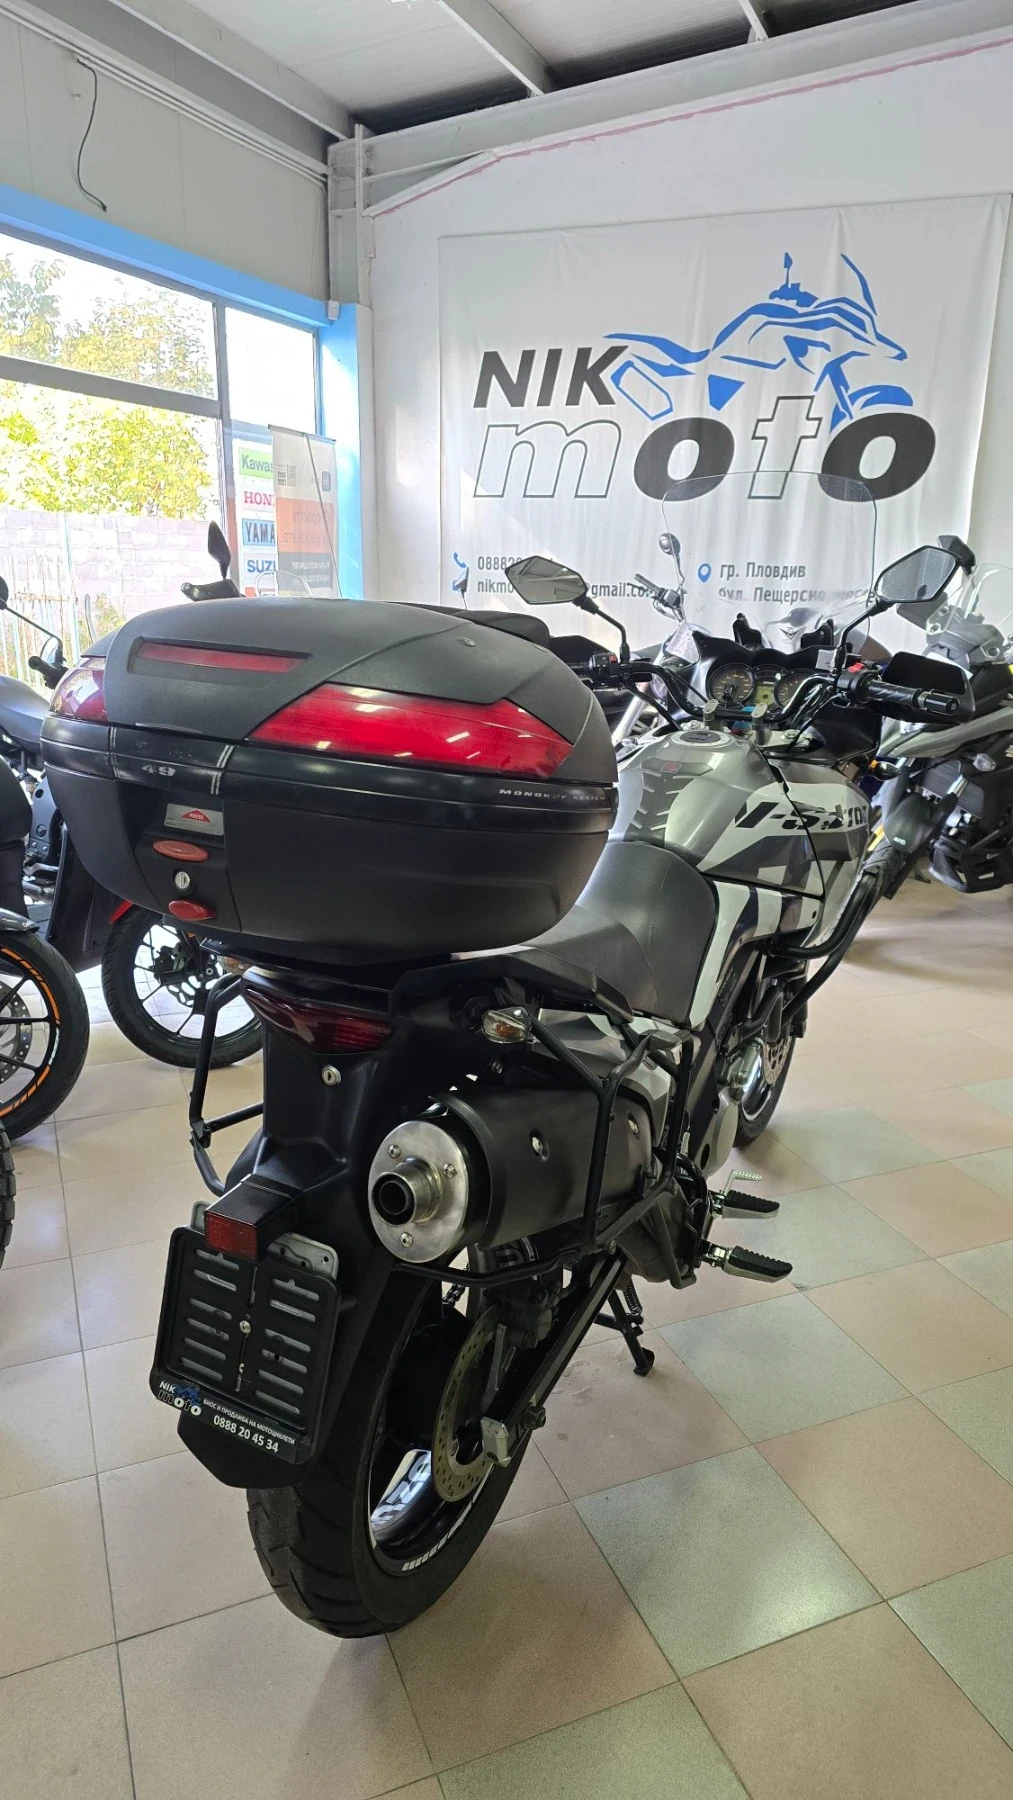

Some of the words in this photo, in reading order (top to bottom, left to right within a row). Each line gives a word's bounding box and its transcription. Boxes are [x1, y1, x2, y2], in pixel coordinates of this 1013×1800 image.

[473, 345, 629, 408] NIK
[473, 394, 936, 502] moto
[241, 453, 274, 473] Kawas
[243, 490, 275, 507] HON
[244, 521, 276, 545] YAMA
[246, 558, 277, 574] SUZ
[719, 563, 740, 580] гр.
[746, 562, 806, 580] Пловдив
[159, 1380, 176, 1394] NIK
[157, 1390, 202, 1416] moto
[213, 1414, 237, 1434] 0888
[237, 1425, 251, 1440] 20
[251, 1433, 265, 1447] 45
[265, 1438, 279, 1453] 34
